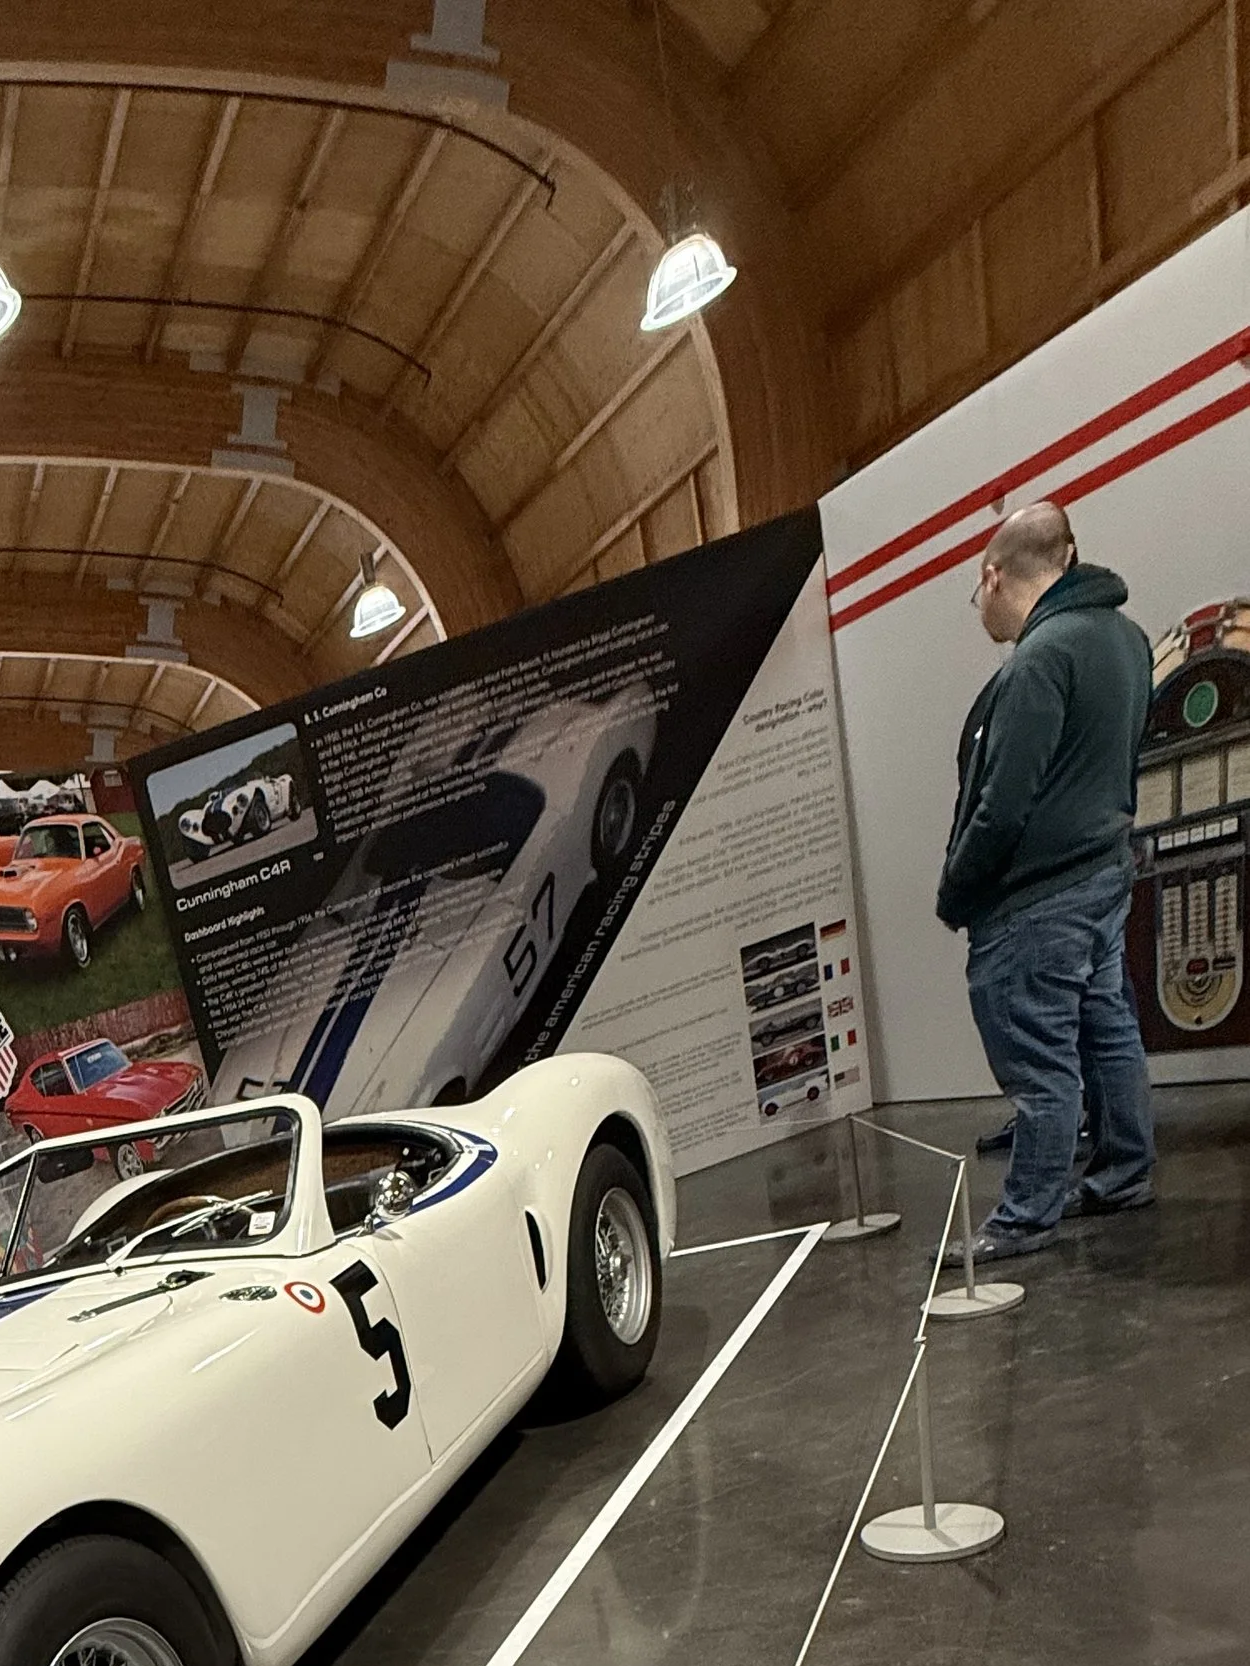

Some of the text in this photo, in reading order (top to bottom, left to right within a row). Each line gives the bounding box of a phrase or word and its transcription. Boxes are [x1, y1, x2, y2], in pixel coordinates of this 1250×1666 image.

[322, 690, 373, 718] Cunningham
[176, 873, 258, 912] Cunningham
[184, 919, 227, 943] Dashboard
[525, 800, 676, 1062] the american racing stripes
[329, 1259, 411, 1430] 5
